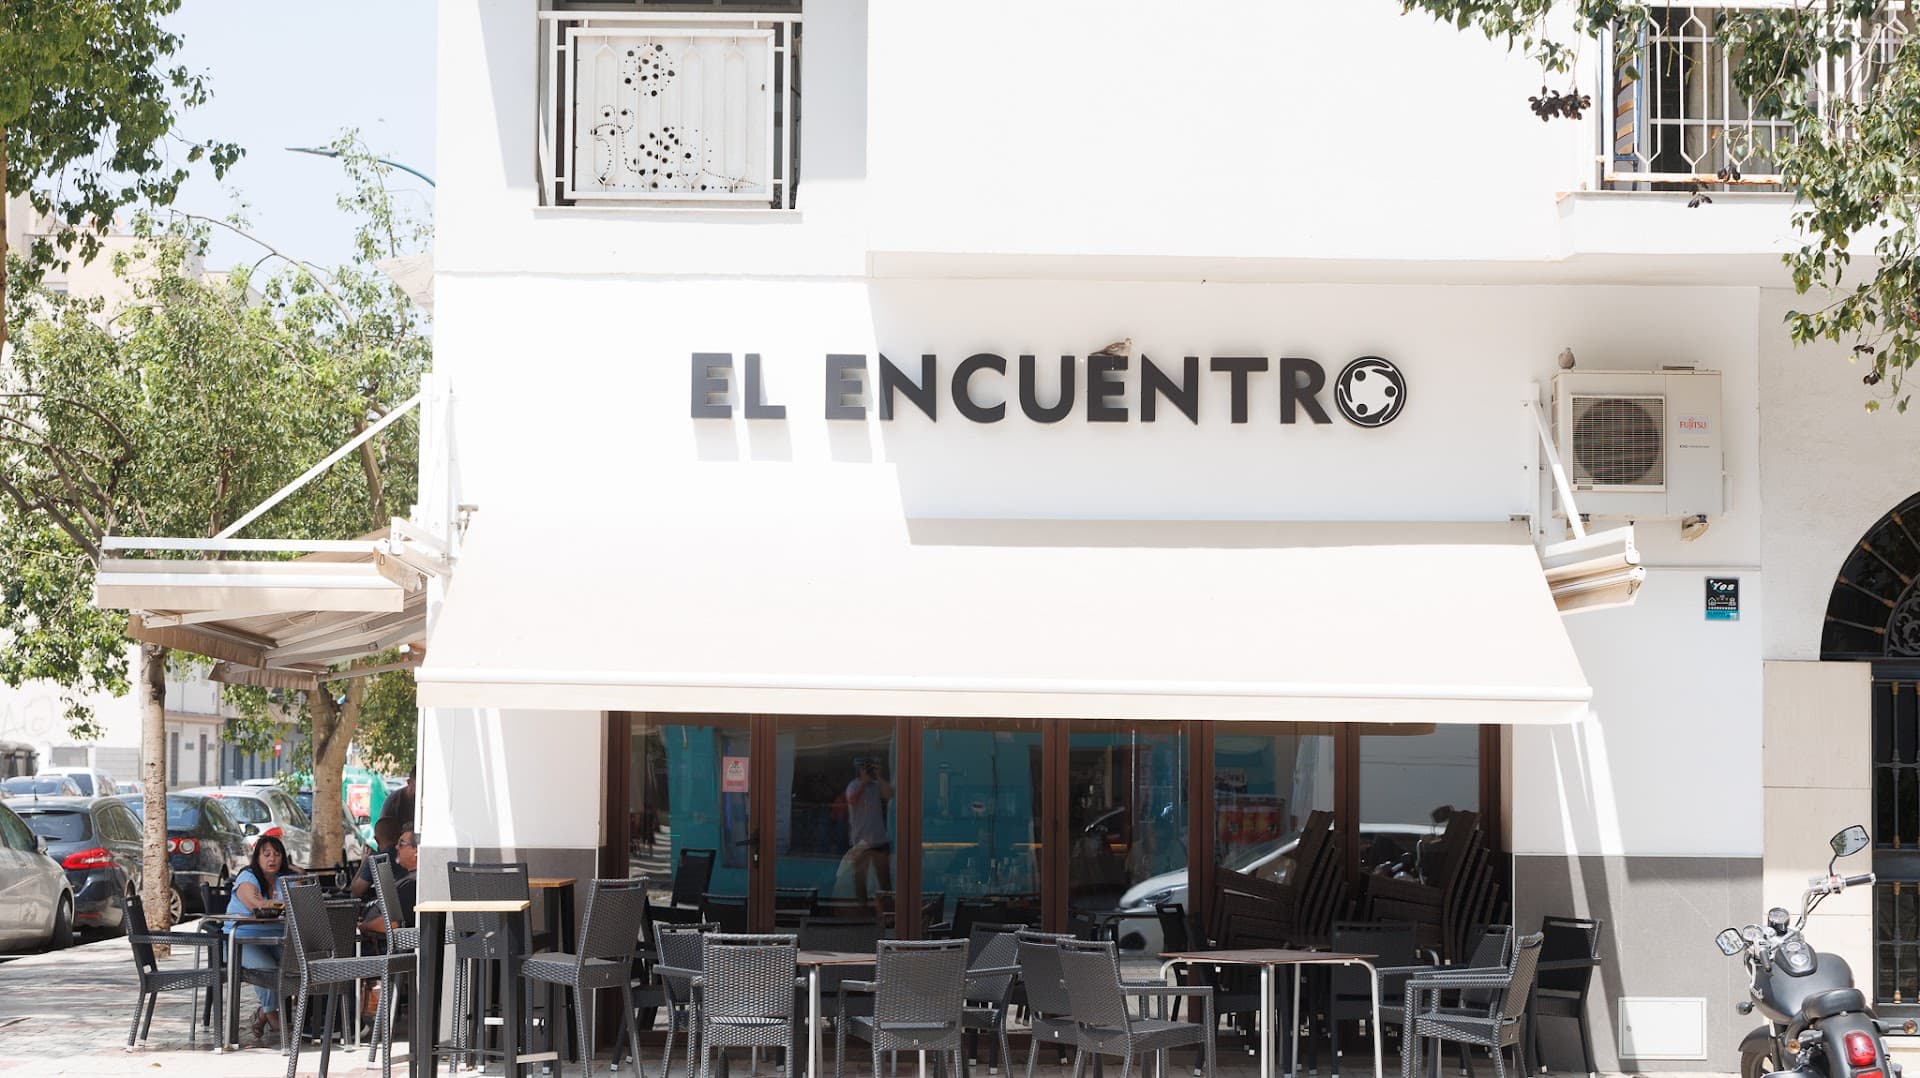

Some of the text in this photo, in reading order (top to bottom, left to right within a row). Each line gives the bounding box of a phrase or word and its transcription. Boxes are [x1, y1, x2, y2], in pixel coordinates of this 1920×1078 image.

[691, 352, 1407, 428] EL ENCUENTRO
[1679, 418, 1708, 430] FUJITSU
